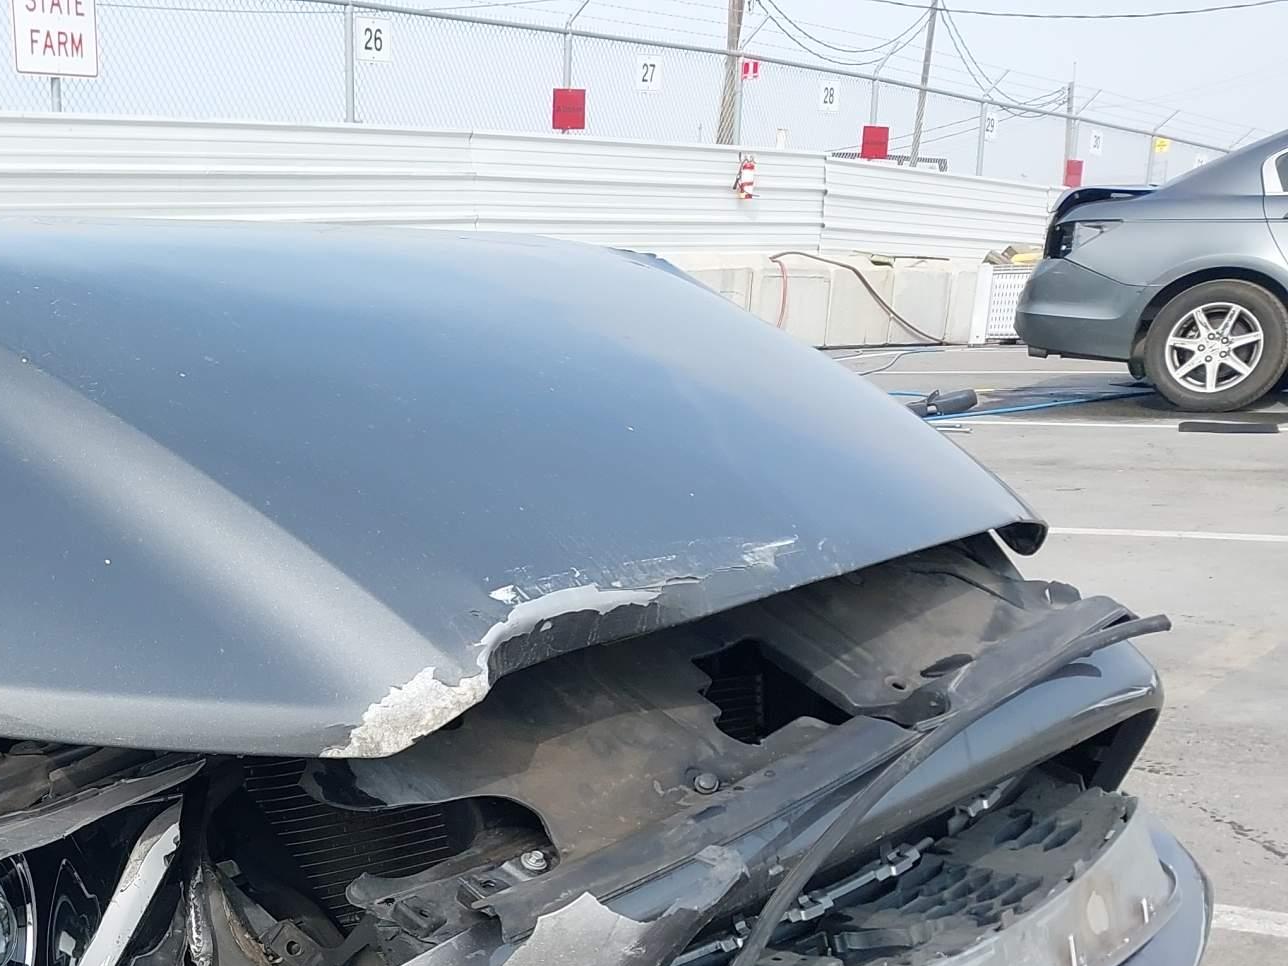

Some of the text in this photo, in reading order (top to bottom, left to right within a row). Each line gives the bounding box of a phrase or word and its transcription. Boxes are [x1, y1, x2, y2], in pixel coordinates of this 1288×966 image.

[29, 29, 84, 59] FARM
[364, 28, 383, 51] 26
[641, 63, 656, 82] 27
[823, 87, 835, 105] 28
[985, 117, 995, 133] 29
